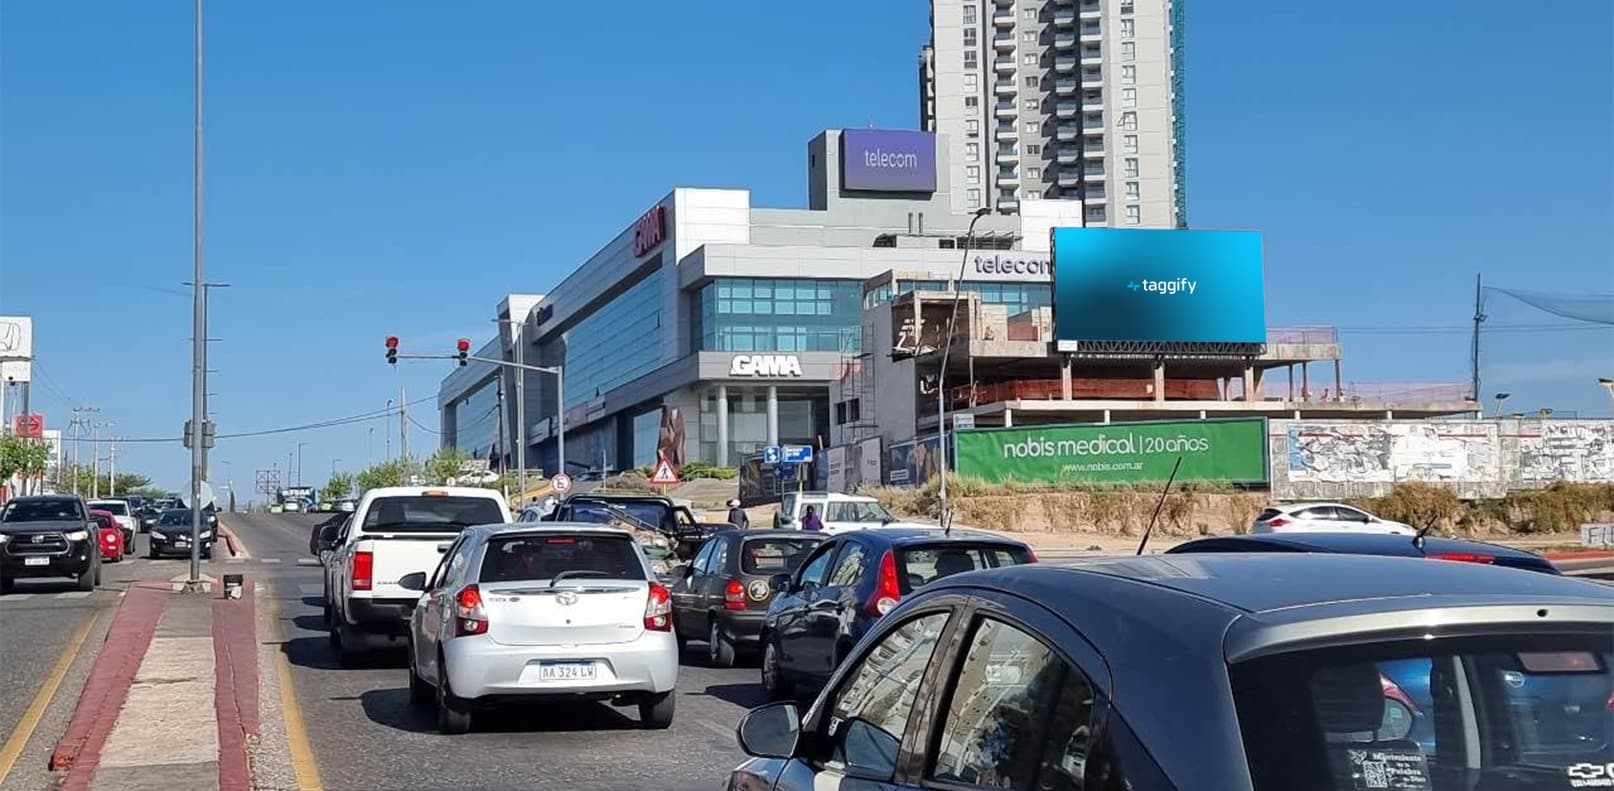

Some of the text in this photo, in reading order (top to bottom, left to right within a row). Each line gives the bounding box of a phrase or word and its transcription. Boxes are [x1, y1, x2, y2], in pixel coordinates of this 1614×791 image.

[865, 148, 918, 168] telecom
[633, 204, 666, 257] GAMA
[1142, 277, 1197, 295] taggify
[730, 354, 803, 376] GAMA
[1004, 433, 1209, 458] nobis medical 20 años
[1064, 460, 1144, 473] www.nobis.com.ar
[559, 666, 577, 678] 324
